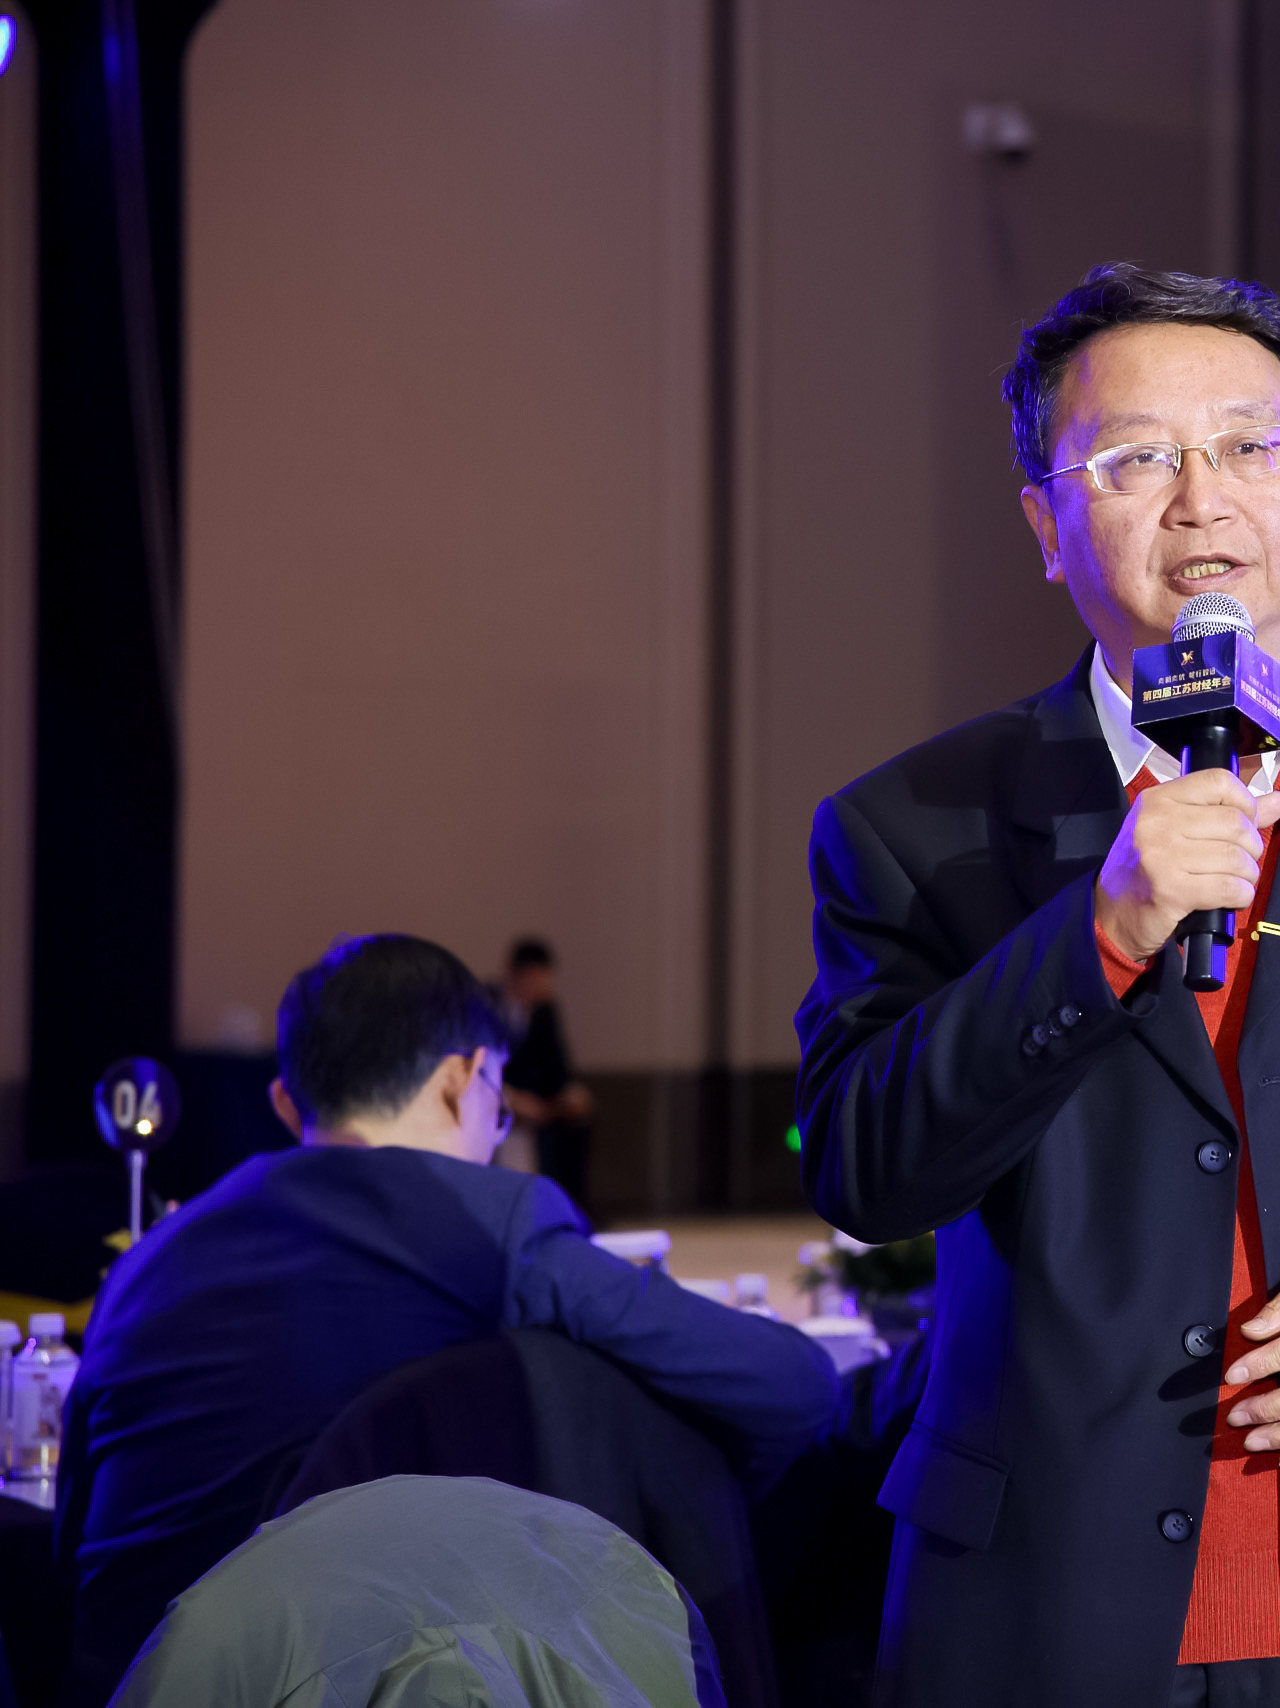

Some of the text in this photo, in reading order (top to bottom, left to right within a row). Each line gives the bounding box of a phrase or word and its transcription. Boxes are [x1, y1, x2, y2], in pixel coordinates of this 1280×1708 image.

[1143, 676, 1231, 702] 第四届江苏财经年会
